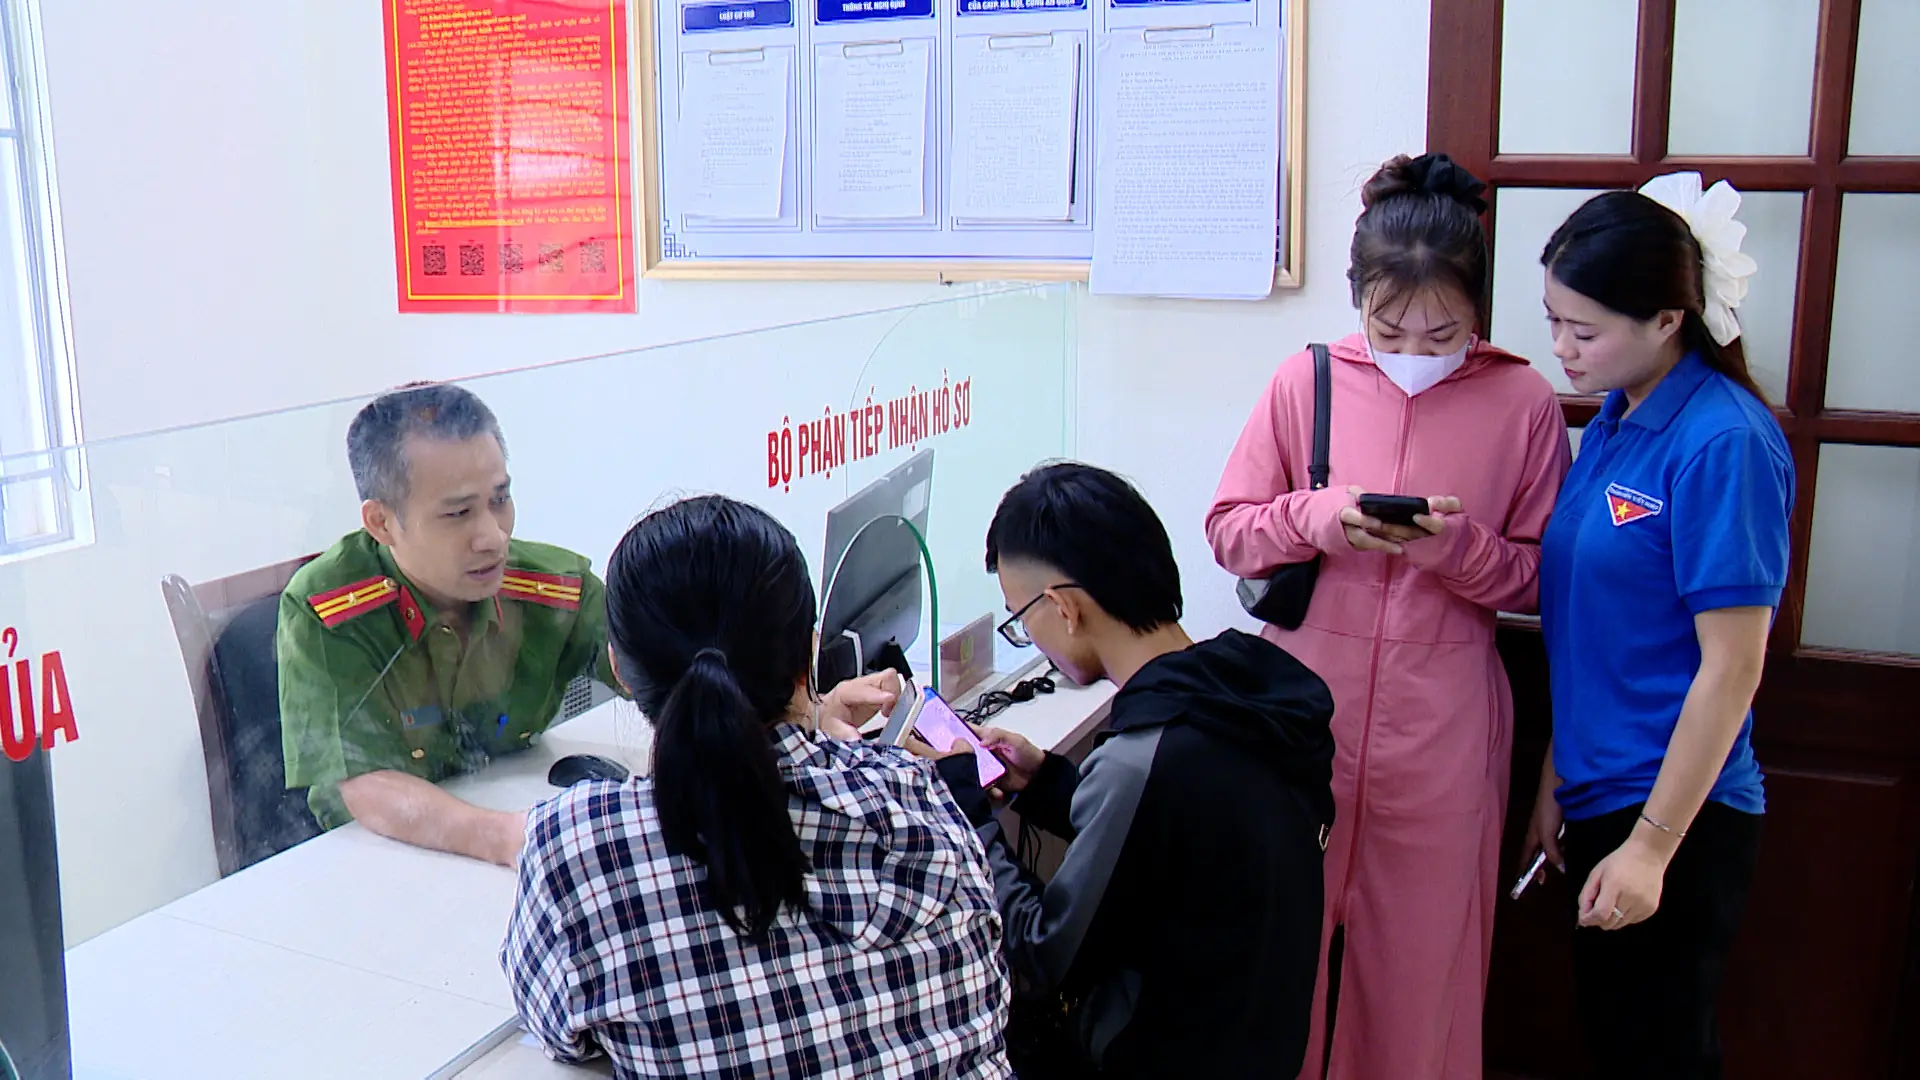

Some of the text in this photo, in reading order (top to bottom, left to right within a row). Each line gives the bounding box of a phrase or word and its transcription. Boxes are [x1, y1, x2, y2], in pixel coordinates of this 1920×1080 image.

[767, 367, 971, 494] BỘ PHẬN TIẾP NHẬN HỒ SƠ
